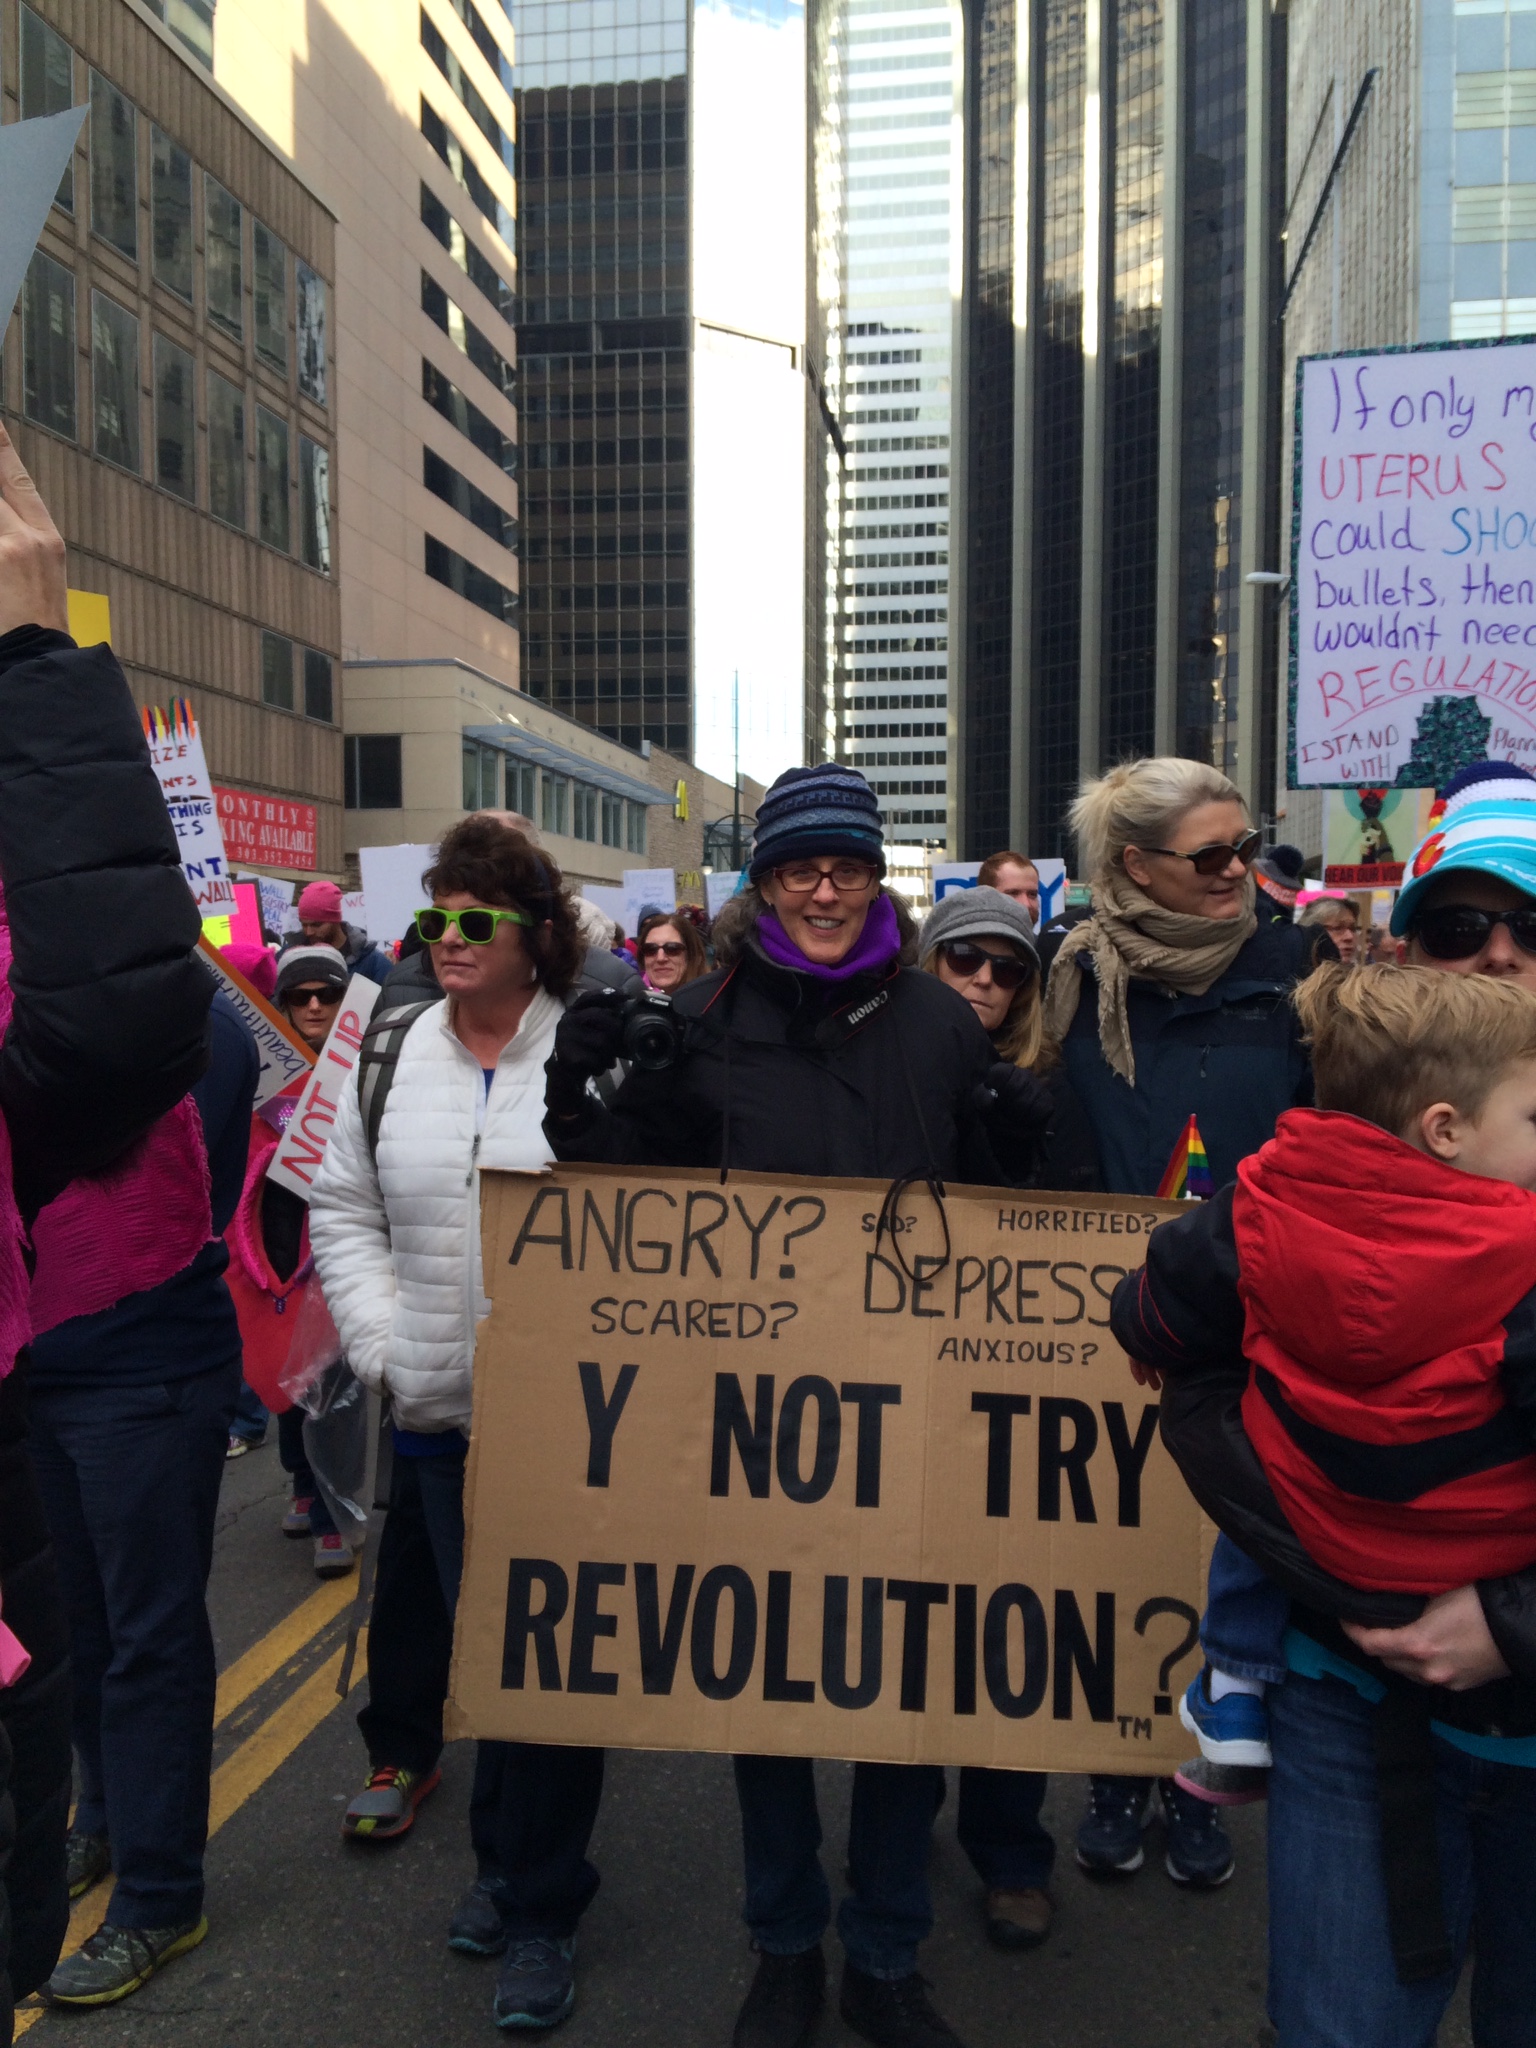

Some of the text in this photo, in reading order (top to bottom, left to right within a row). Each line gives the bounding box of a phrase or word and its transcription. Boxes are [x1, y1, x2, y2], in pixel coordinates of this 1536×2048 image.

[1330, 366, 1377, 434] If
[1390, 375, 1475, 439] only
[1320, 442, 1507, 503] UTERUS
[1461, 562, 1534, 605] then
[1317, 654, 1536, 718] REGULATIO
[162, 774, 197, 788] NTS
[1341, 752, 1391, 779] WITH
[213, 792, 299, 825] ONTHLY
[175, 820, 205, 837] IS
[217, 816, 314, 853] KING AVAILABLE
[185, 856, 222, 881] NT
[195, 880, 235, 906] WALL
[848, 990, 888, 1024] Canon
[281, 1081, 338, 1185] NOT
[508, 1186, 826, 1280] ANGRY?
[998, 1209, 1158, 1235] HORRIFIED?
[864, 1252, 1137, 1328] DEPRESS
[591, 1297, 799, 1340] SCARED?
[938, 1337, 1099, 1366] ANXIOUS?
[578, 1361, 1161, 1528] Y NOT TRY
[1117, 1714, 1153, 1740] TM
